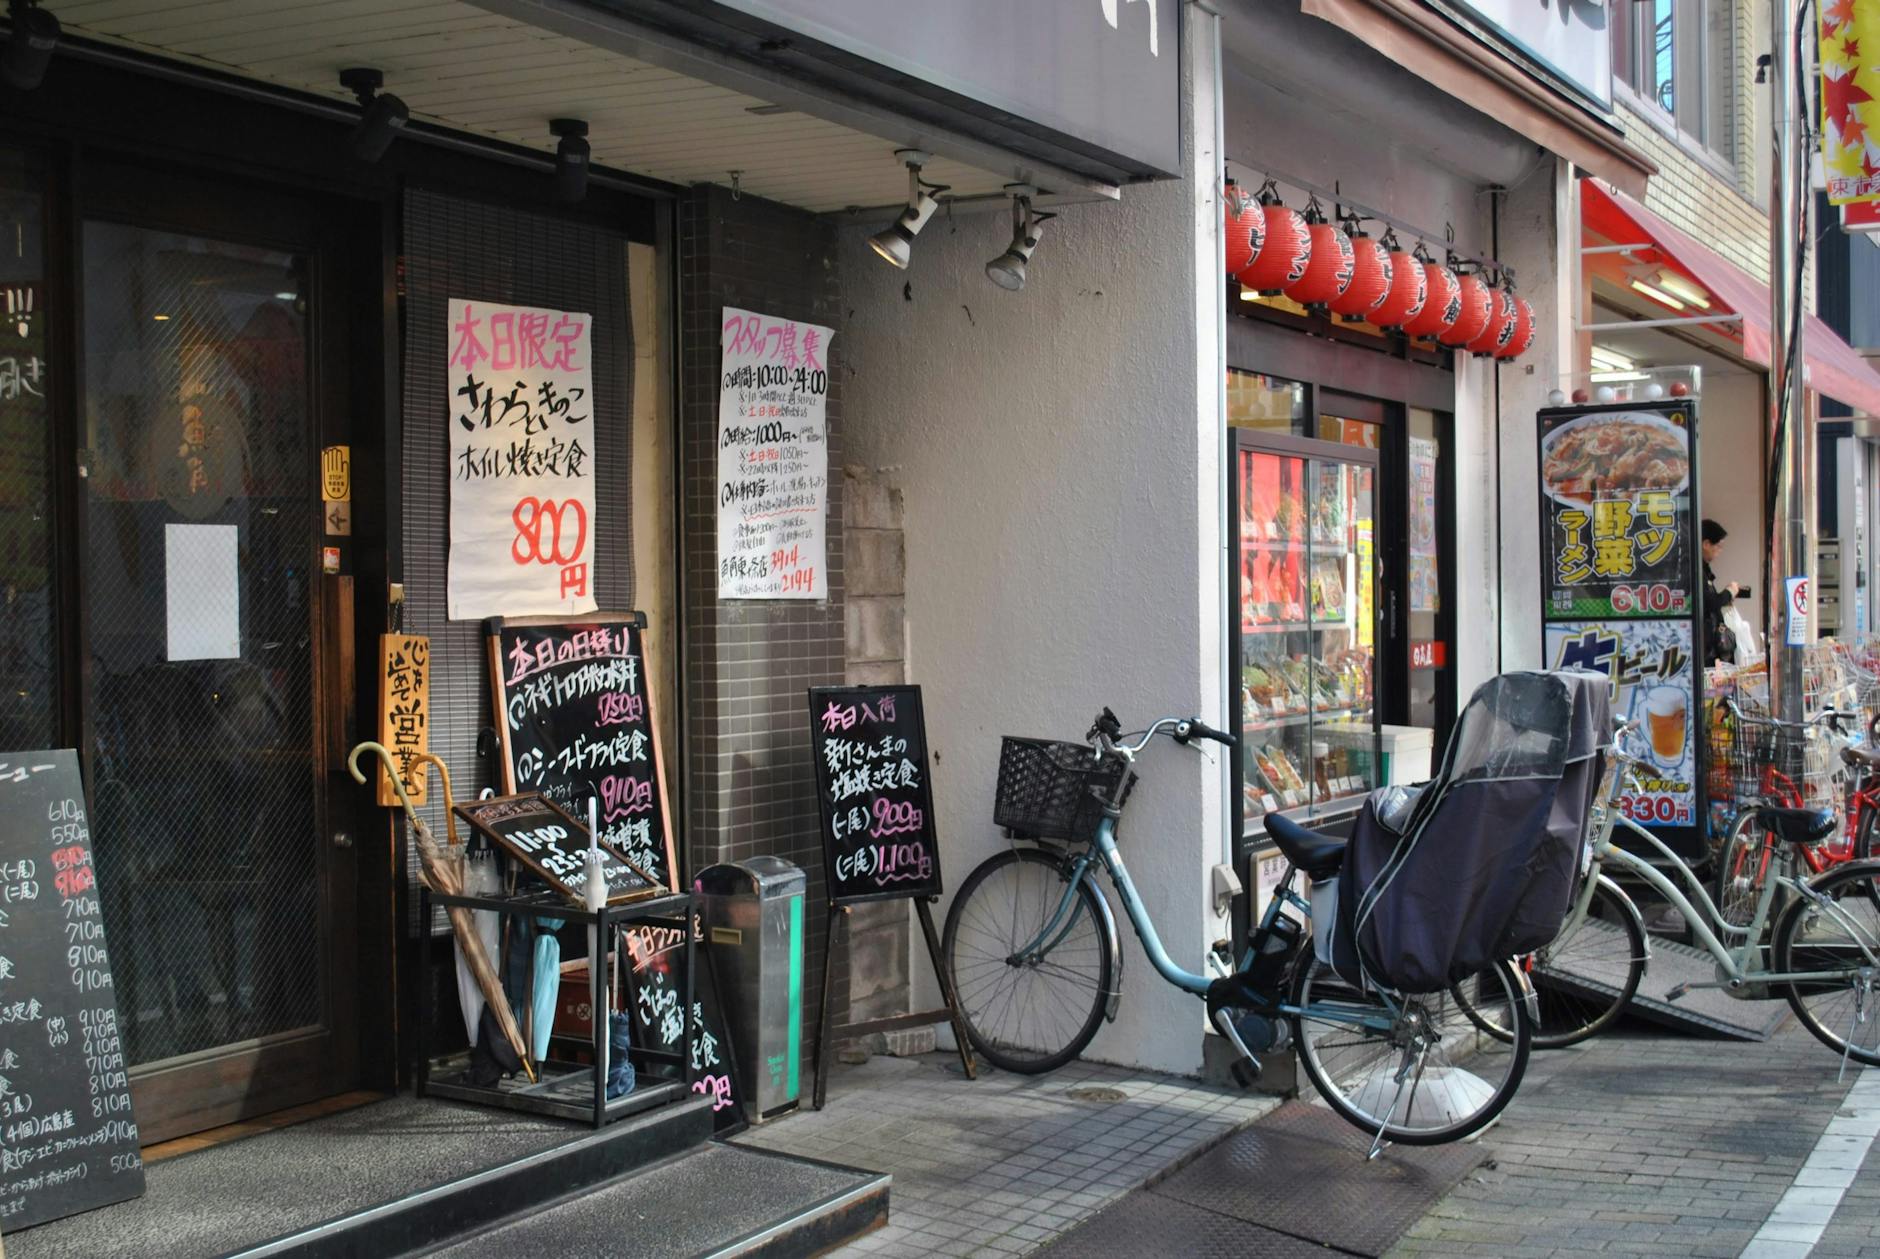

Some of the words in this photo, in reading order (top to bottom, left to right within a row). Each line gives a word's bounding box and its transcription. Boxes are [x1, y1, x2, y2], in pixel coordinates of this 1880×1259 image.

[450, 304, 584, 373] 本日限定
[1592, 500, 1635, 577] 野菜
[1636, 491, 1677, 567] モツ
[1557, 510, 1592, 585] ラーメン
[821, 695, 897, 734] 本日入荷
[823, 734, 908, 774] 新さんまの
[830, 757, 920, 803] 塩焼き定食
[48, 799, 85, 822] 610円
[871, 797, 924, 833] 900円
[51, 823, 89, 845] 550円
[61, 897, 100, 919] 710円
[65, 920, 105, 943] 710円
[68, 945, 107, 968] 810円
[72, 968, 112, 993] 910円
[79, 1007, 116, 1026] 910円
[82, 1022, 118, 1041] 710円
[83, 1036, 121, 1057] 910円
[86, 1052, 124, 1074] 710円
[89, 1071, 127, 1095] 810円
[91, 1093, 132, 1118] 810円
